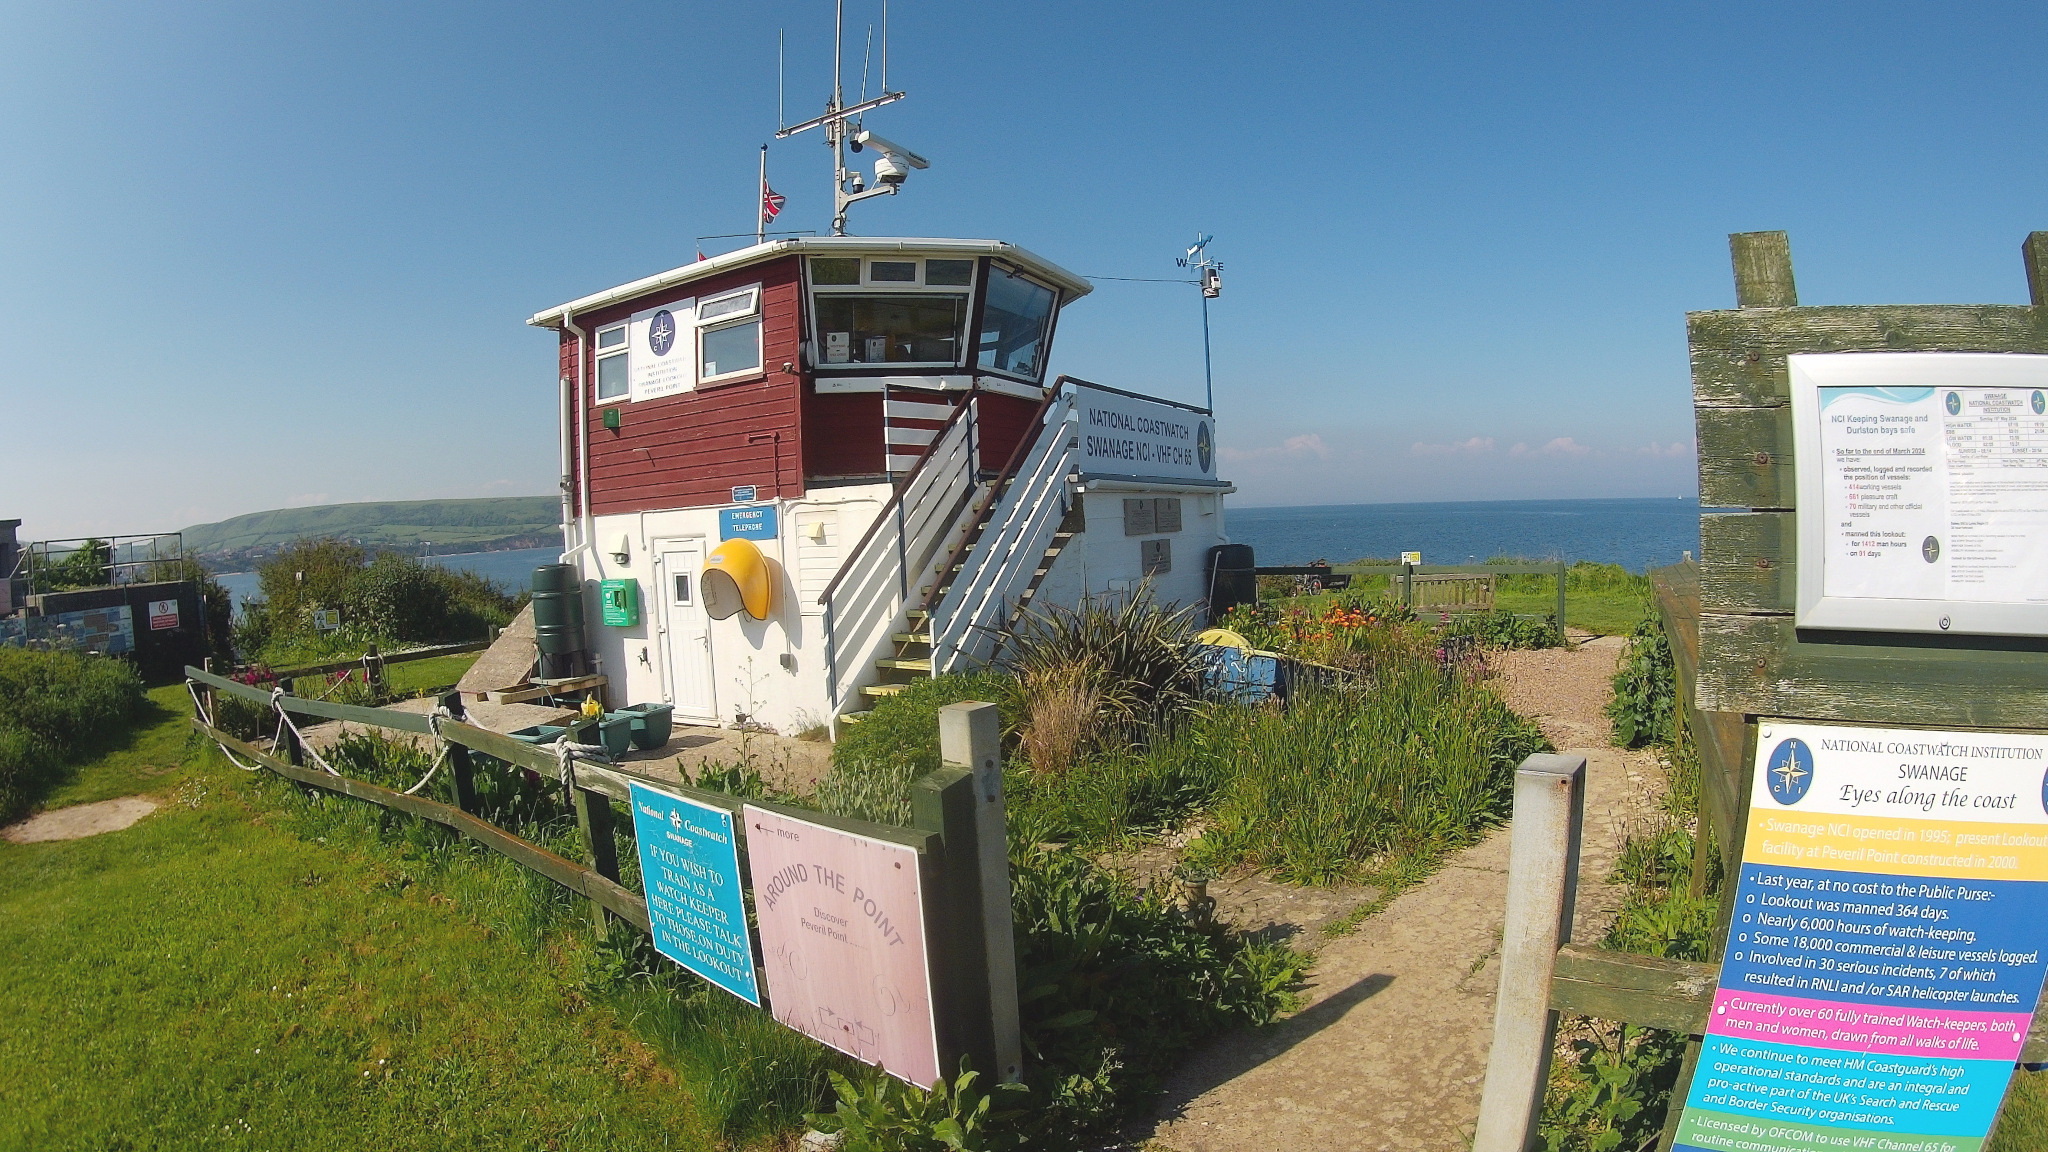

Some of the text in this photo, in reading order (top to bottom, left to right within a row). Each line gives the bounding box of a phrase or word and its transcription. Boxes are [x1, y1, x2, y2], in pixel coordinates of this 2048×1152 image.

[1176, 258, 1187, 267] W
[1218, 262, 1224, 270] E
[1089, 408, 1189, 440] NATIONAL COASTWATCH
[1831, 414, 1928, 424] NCI Keeping Swanage and
[1846, 426, 1916, 436] Durlston bays safe
[1087, 435, 1192, 466] SWANAGE NCI VHF CH 65
[1821, 738, 2043, 760] NATIONAL COASTWATCH INSTITUTION
[1898, 764, 1968, 782] SWANAGE
[1839, 784, 2017, 812] Eyes along the coast
[638, 801, 728, 844] National Coastwatch
[777, 828, 800, 842] more
[1766, 818, 2048, 847] Swanage NCI opened in 1995; present Lookout
[666, 831, 693, 848] SWANAGE
[1762, 840, 2018, 869] facility at Peveril Point constructed in 2000.
[650, 844, 724, 886] IF YOU WISH TO
[661, 866, 716, 902] TRAIN AS A
[1757, 872, 1784, 886] Last
[1785, 877, 1815, 891] year,
[1818, 879, 1830, 891] at
[1832, 881, 1850, 892] no
[1852, 882, 1878, 894] cost
[1880, 883, 1894, 896] to
[1896, 883, 1916, 898] the
[1919, 884, 1956, 900] Public
[656, 880, 730, 925] WATCH KEEPER
[764, 864, 904, 946] AROUND THE POINT
[814, 906, 848, 928] Discover
[1761, 892, 1950, 922] Lookout was manned 364 days.
[652, 893, 742, 948] HERE PLEASE TALK
[801, 918, 826, 936] Peveril
[1757, 912, 1976, 944] Nearly 6,000 hours of watch-keeping.
[654, 910, 744, 966] TO THOSE ON DUTY
[1753, 932, 2038, 966] Some 18,000 commercial & leisure vessels logged.
[662, 930, 742, 982] IN THE LOOKOUT
[1748, 950, 1996, 982] Involved in 30 serious incidents, 7 of which
[1744, 972, 1796, 988] resulted
[1797, 976, 1808, 989] in
[1811, 978, 1840, 992] RNLI
[1841, 982, 1866, 995] and
[1886, 984, 1910, 998] SAR
[1912, 986, 1970, 1003] helicopter
[1970, 989, 2020, 1004] launches.
[1730, 998, 2016, 1032] Currently over 60 fully trained Watch-keepers, both
[1726, 1018, 1980, 1050] men and women, drawn from all walks of life.
[1720, 1042, 1965, 1080] We continue to meet HM Coastguard's high
